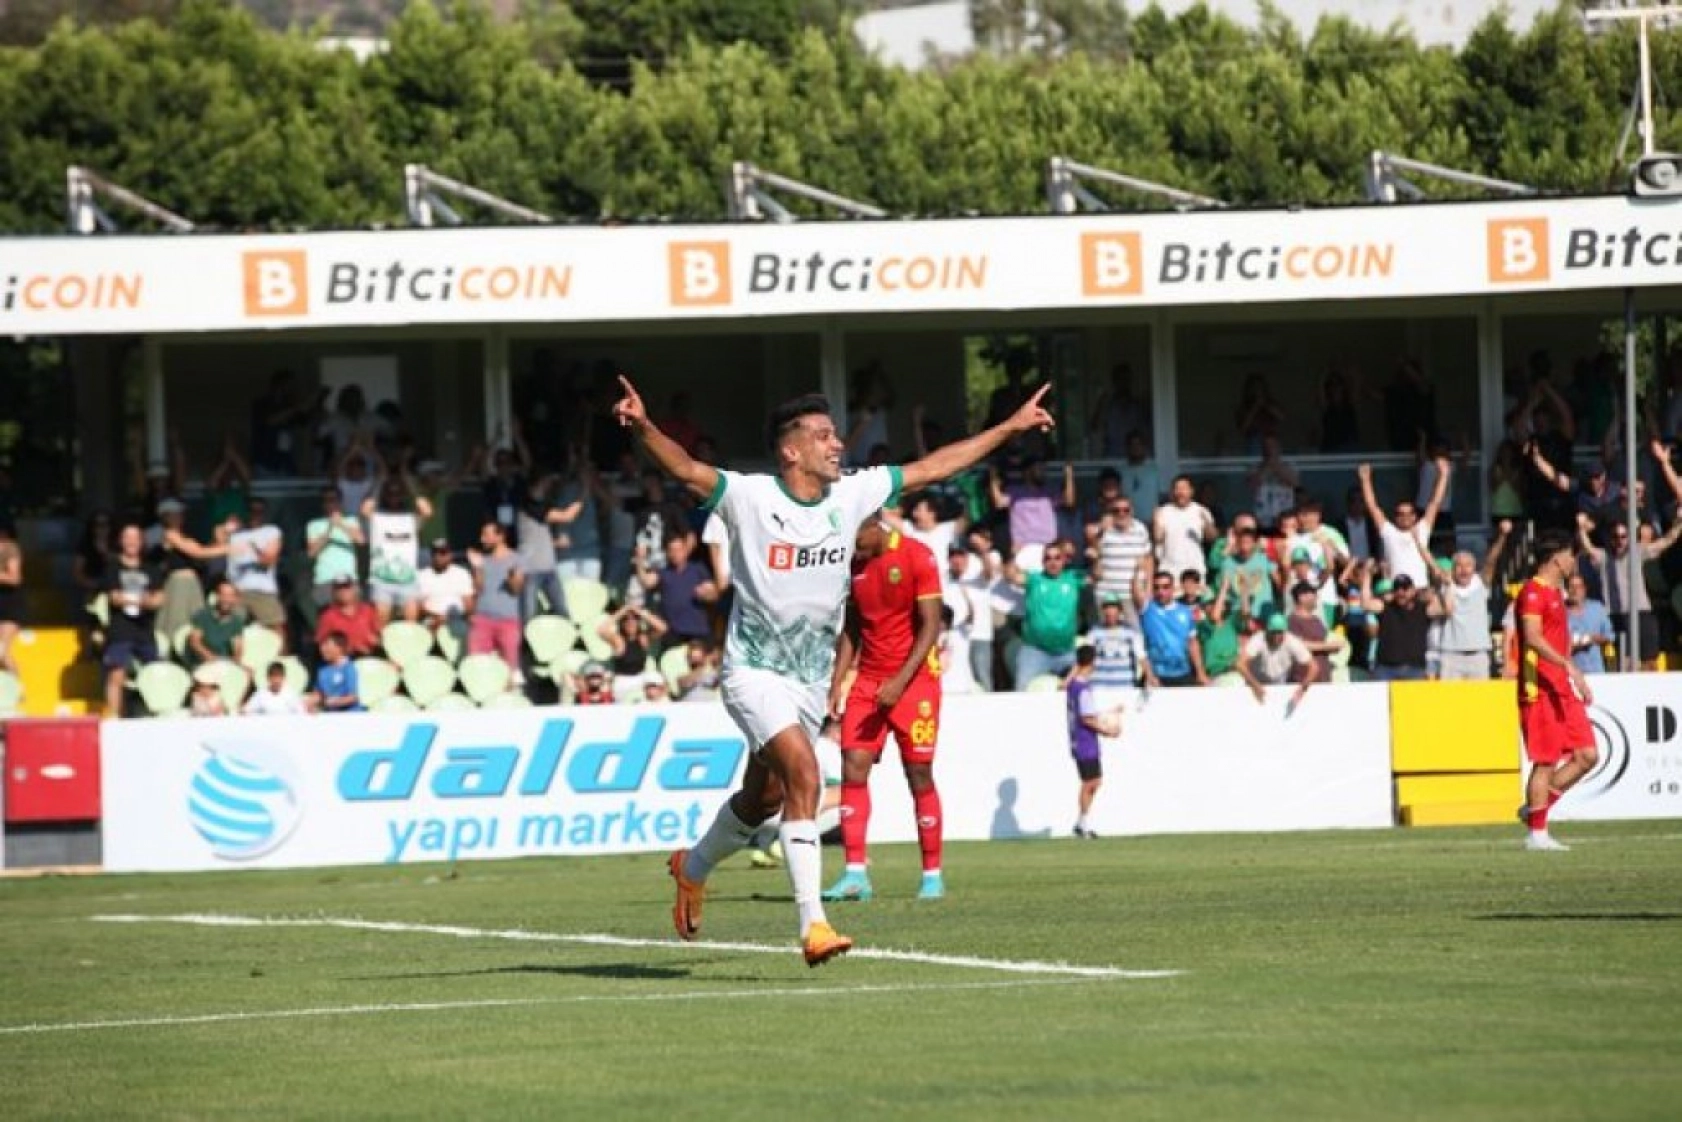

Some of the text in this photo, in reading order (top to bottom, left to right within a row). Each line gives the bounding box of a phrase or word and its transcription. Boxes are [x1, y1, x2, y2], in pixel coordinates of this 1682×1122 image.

[1159, 240, 1395, 284] BitciCOIN
[1564, 226, 1682, 269] Bitci
[326, 259, 574, 305] BitciCOIN
[748, 250, 989, 294] BitciCOIN
[797, 546, 847, 568] Bitci
[336, 714, 746, 801] dalda
[387, 801, 702, 863] yapı market
